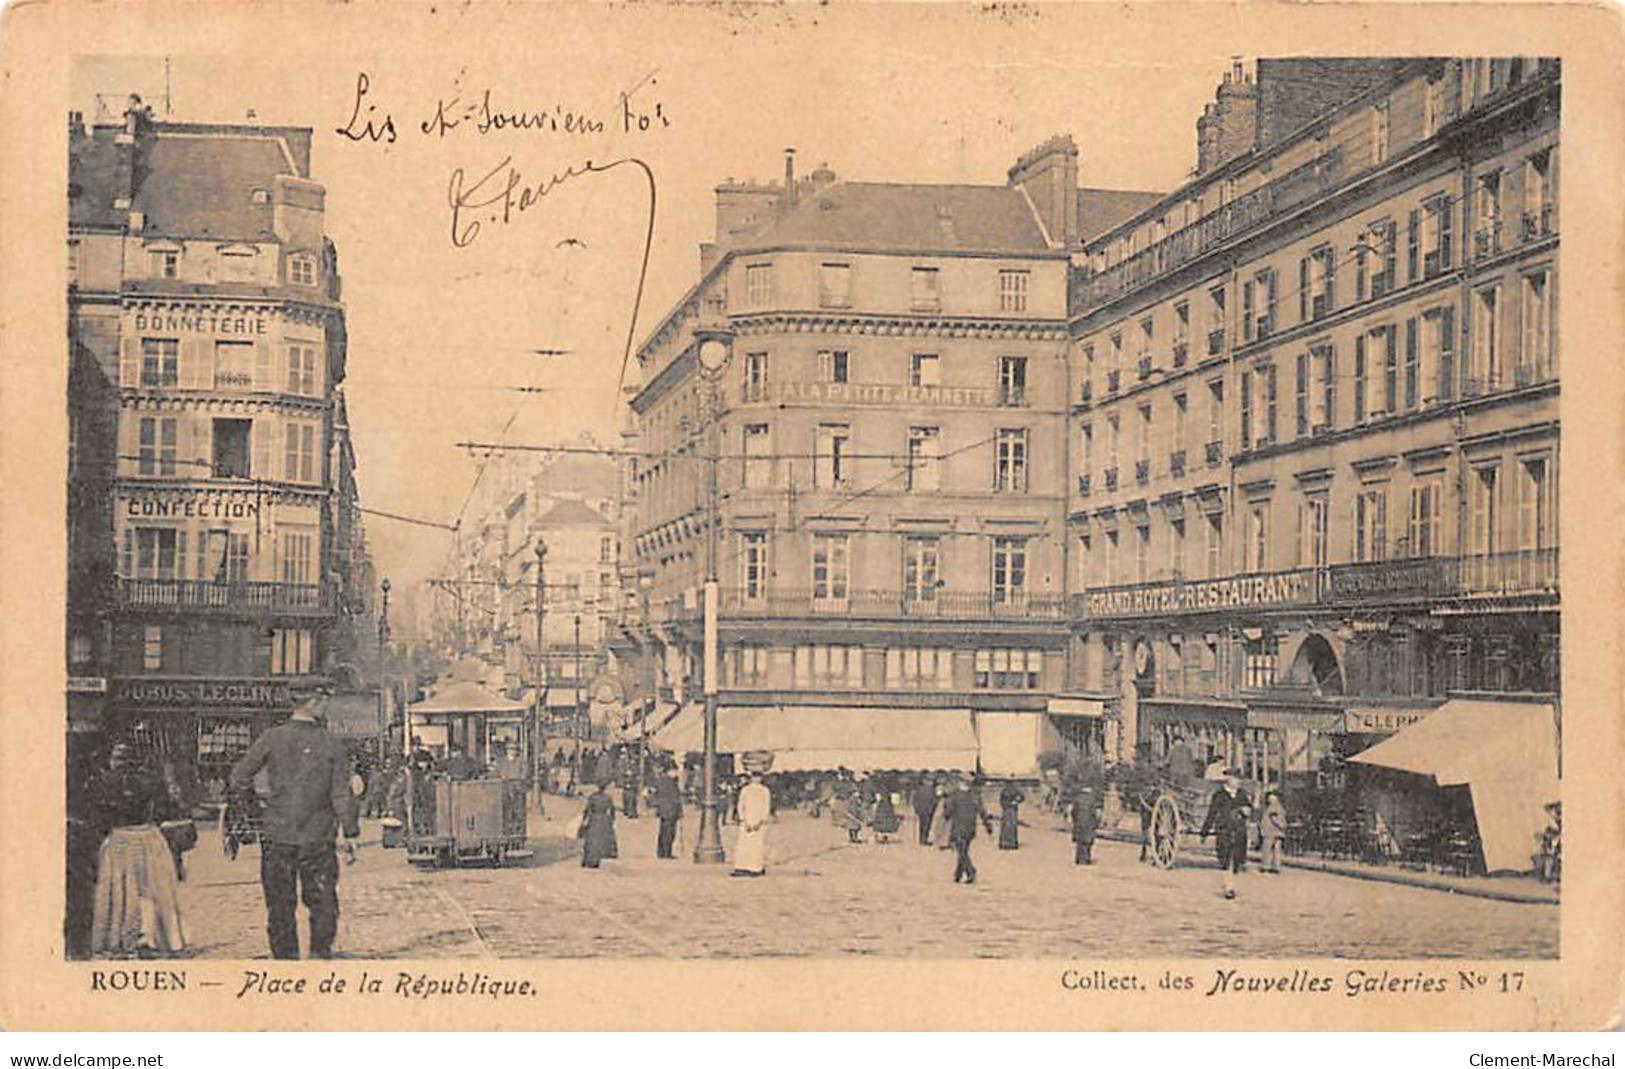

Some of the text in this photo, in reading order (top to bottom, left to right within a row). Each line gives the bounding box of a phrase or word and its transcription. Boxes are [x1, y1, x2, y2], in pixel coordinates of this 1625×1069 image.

[135, 314, 268, 334] BONNETERIE
[127, 500, 259, 518] CONFECTION
[1090, 591, 1131, 615] GRAND
[1350, 710, 1426, 729] TELEPH
[91, 970, 537, 1000] ROUEN Place de la République.
[1061, 970, 1146, 991] Collect.
[1158, 970, 1194, 990] des
[1205, 969, 1334, 997] Nouvelles
[1345, 969, 1448, 997] Galeries
[1498, 971, 1525, 993] 17
